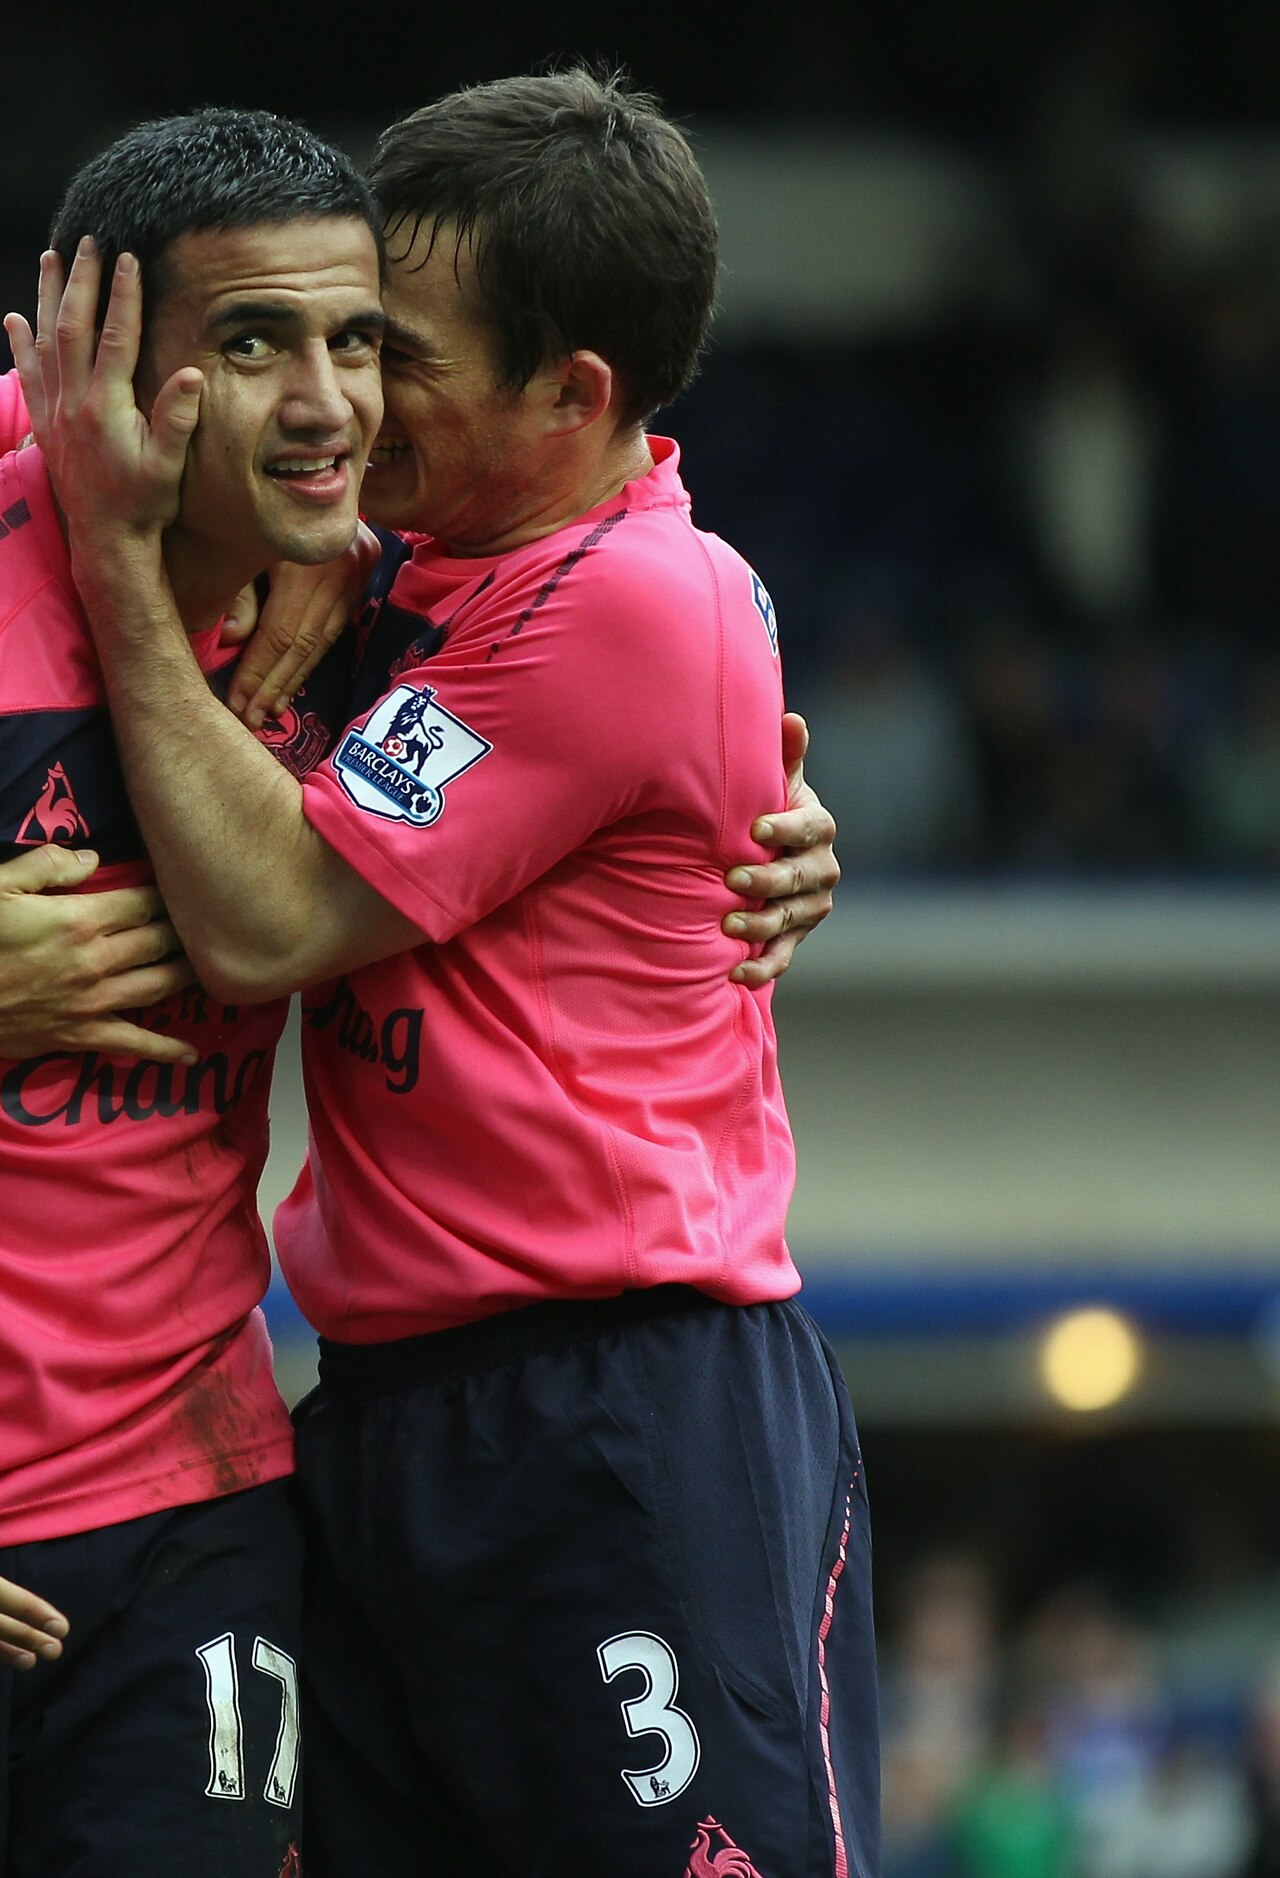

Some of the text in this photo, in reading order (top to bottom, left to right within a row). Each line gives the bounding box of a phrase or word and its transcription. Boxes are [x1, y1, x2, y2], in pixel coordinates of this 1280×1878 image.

[341, 754, 372, 781] PREMIER
[373, 775, 406, 802] LEAGUE
[348, 742, 415, 794] BARCLAYS
[195, 1632, 301, 1808] 17
[596, 1630, 701, 1807] 3
